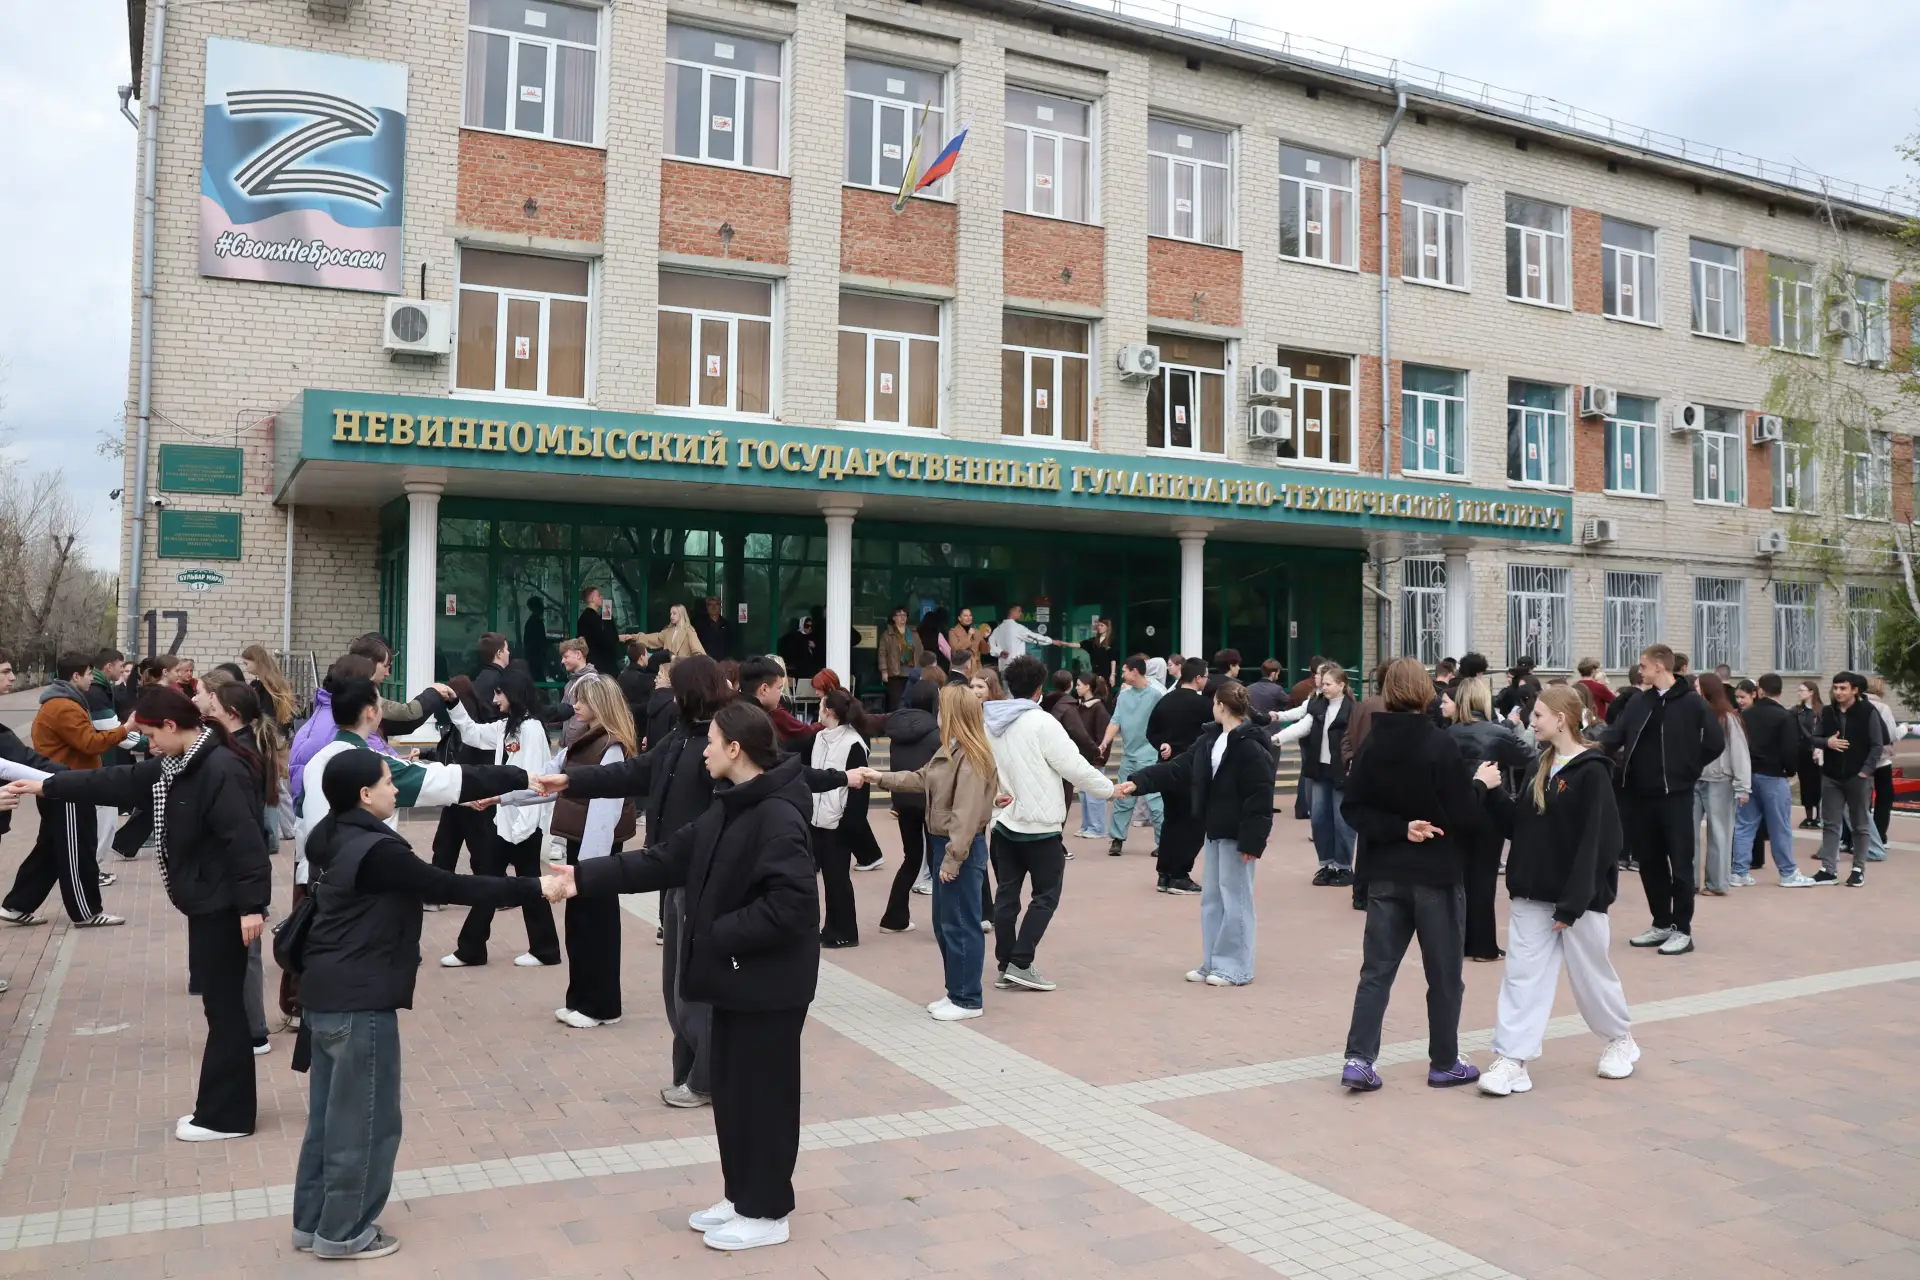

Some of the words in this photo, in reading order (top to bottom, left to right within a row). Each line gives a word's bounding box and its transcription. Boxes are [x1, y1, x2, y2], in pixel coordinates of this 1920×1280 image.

[226, 89, 391, 209] Z
[214, 231, 386, 271] #СвоихНеБросаем
[332, 408, 729, 467] НЕВИННОМЫССКИЙ
[737, 438, 1062, 491] ГОСУДАРСТВЕННЫЙ
[1071, 466, 1455, 522] ГУМАНИТАРНО-ТЕХНИЧЕСКИЙ
[1457, 499, 1564, 530] ИНСТИТУТ
[179, 573, 205, 582] БУЛЬВАР
[206, 573, 222, 583] МИРА
[143, 610, 188, 659] 17
